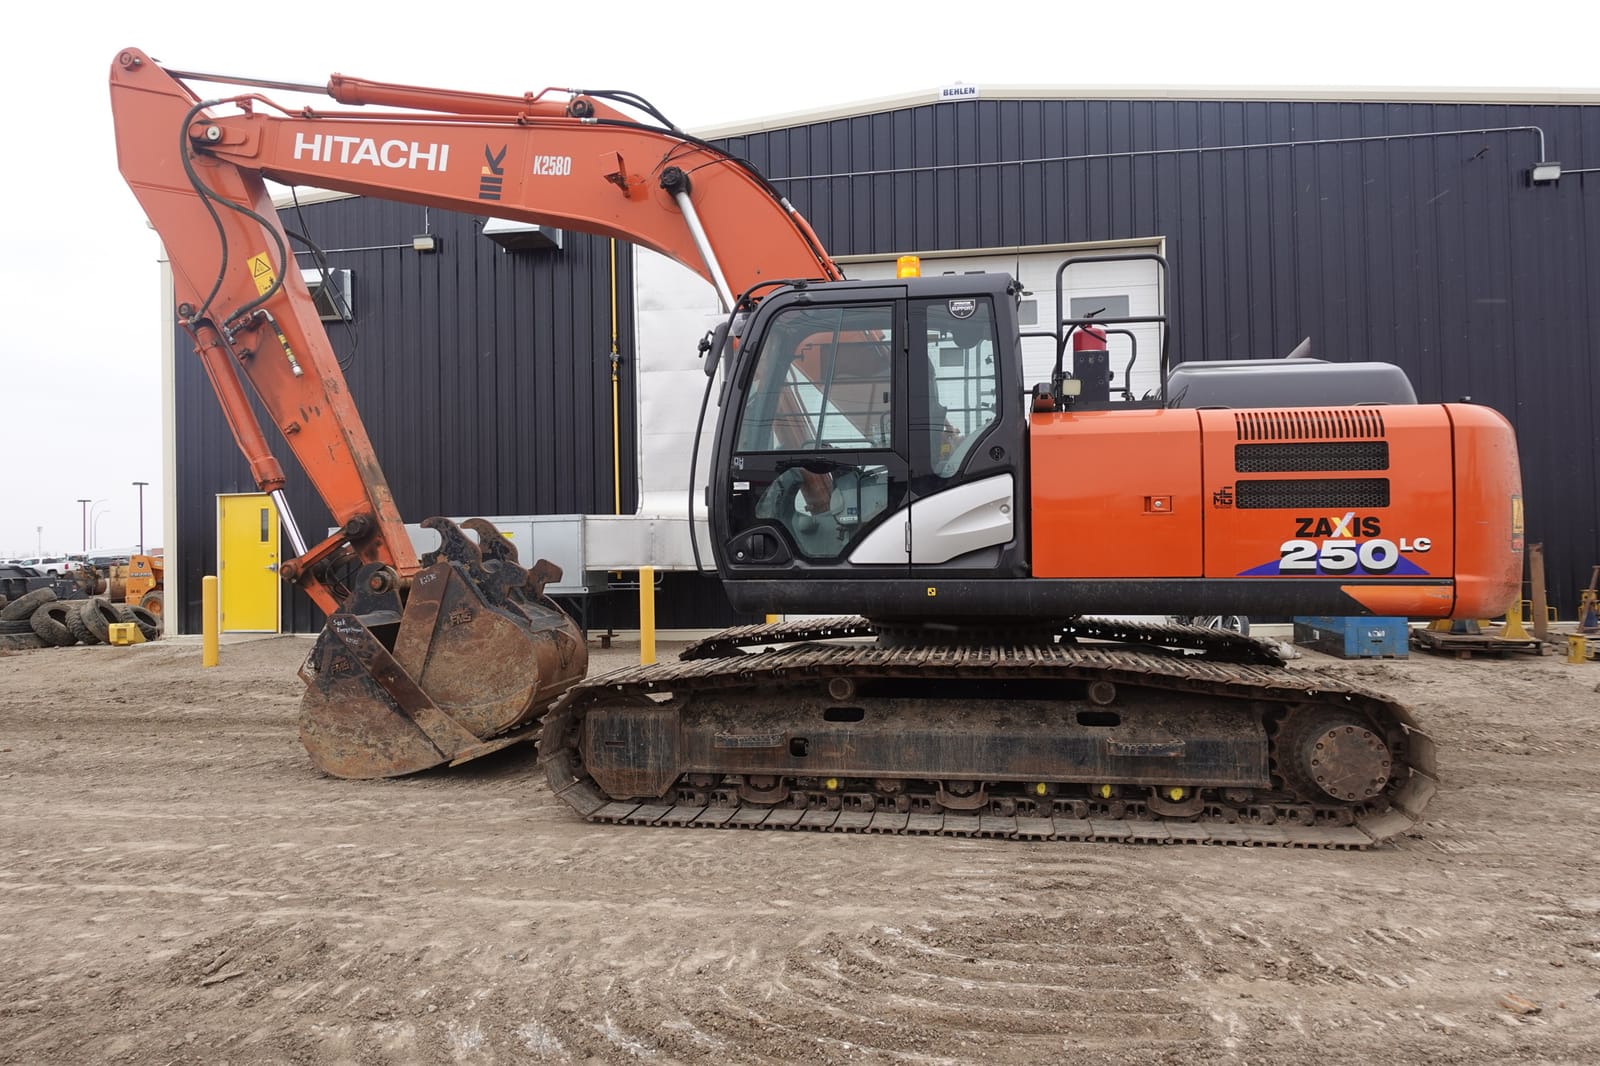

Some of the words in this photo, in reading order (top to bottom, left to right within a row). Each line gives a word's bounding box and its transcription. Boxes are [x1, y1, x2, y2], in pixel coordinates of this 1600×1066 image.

[943, 87, 976, 97] BEHLEN
[293, 132, 450, 172] HITACHI
[532, 154, 572, 177] K2580
[1295, 511, 1381, 538] ZAXIS
[1278, 538, 1399, 575] 250
[1399, 537, 1432, 553] LC
